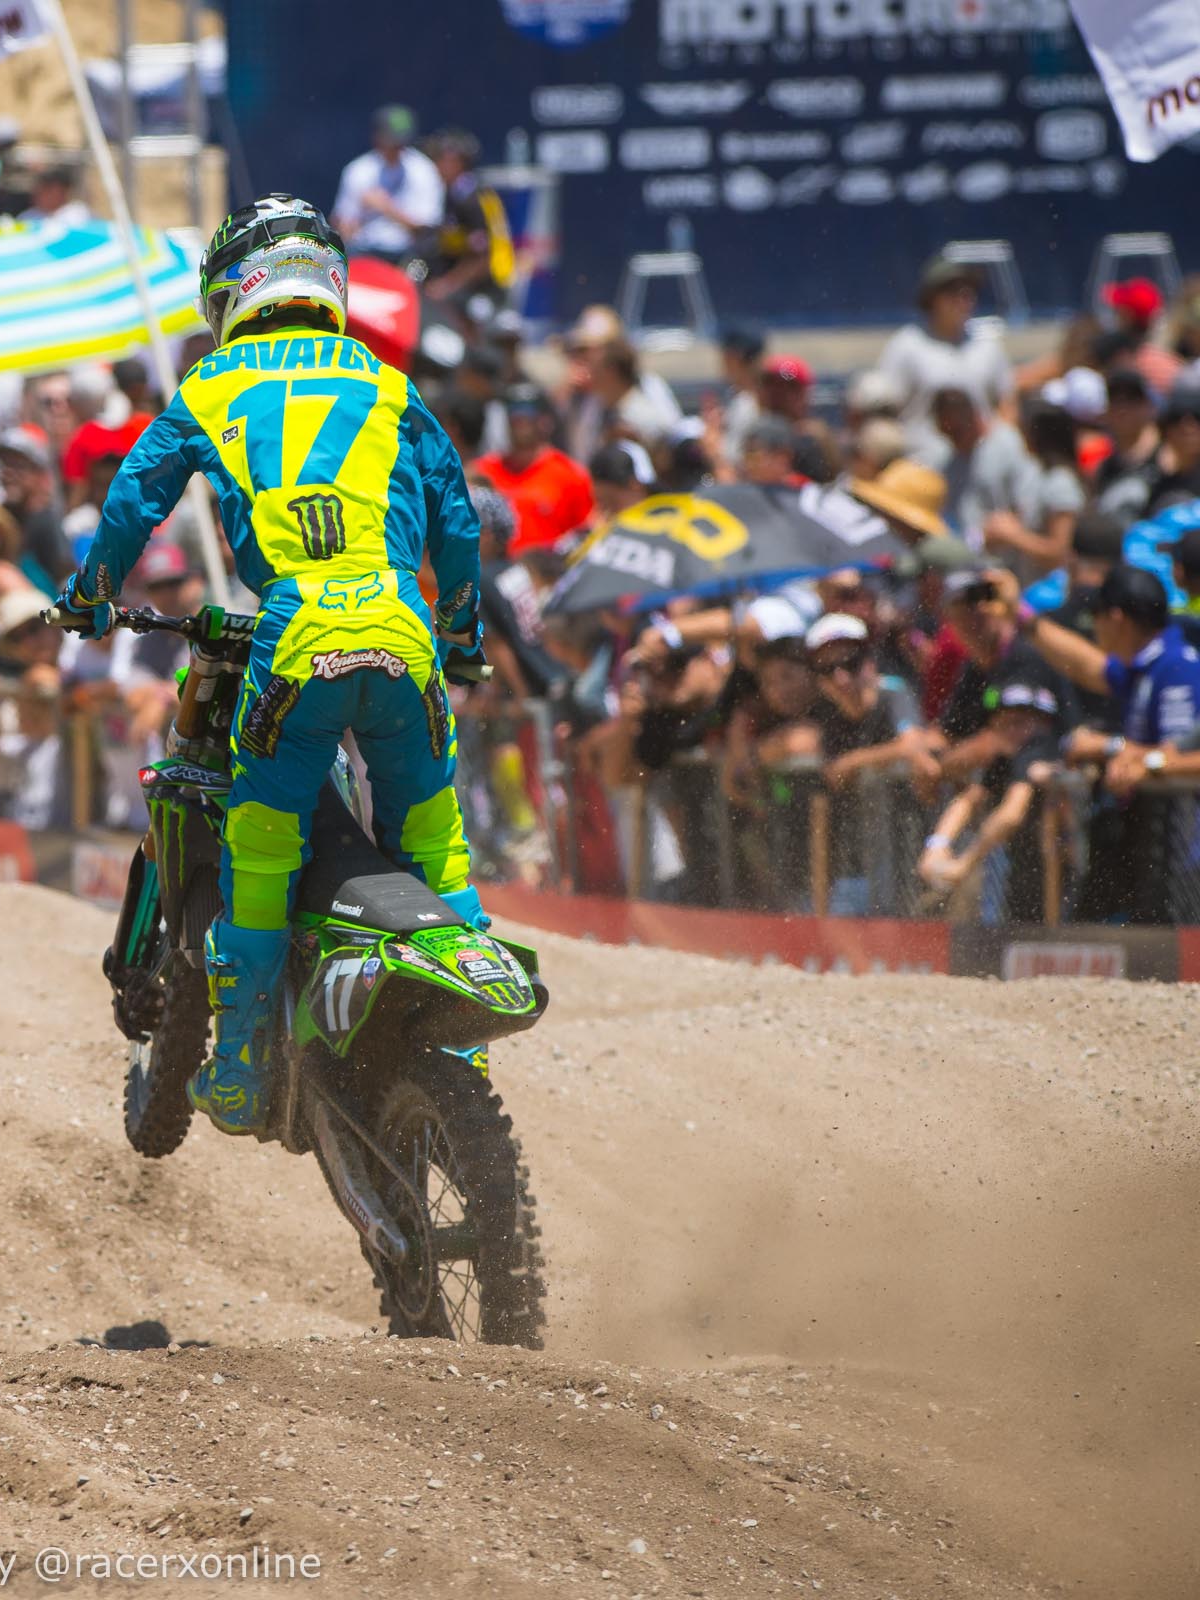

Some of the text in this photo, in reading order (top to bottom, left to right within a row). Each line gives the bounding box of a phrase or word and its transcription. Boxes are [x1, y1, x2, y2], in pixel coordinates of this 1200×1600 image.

[241, 269, 267, 294] BELL
[330, 270, 344, 295] BELL
[199, 336, 383, 381] SAVATGY
[227, 377, 378, 495] 17
[313, 650, 382, 679] Kentucky
[331, 900, 365, 918] Kawasaki
[323, 957, 365, 1032] 17
